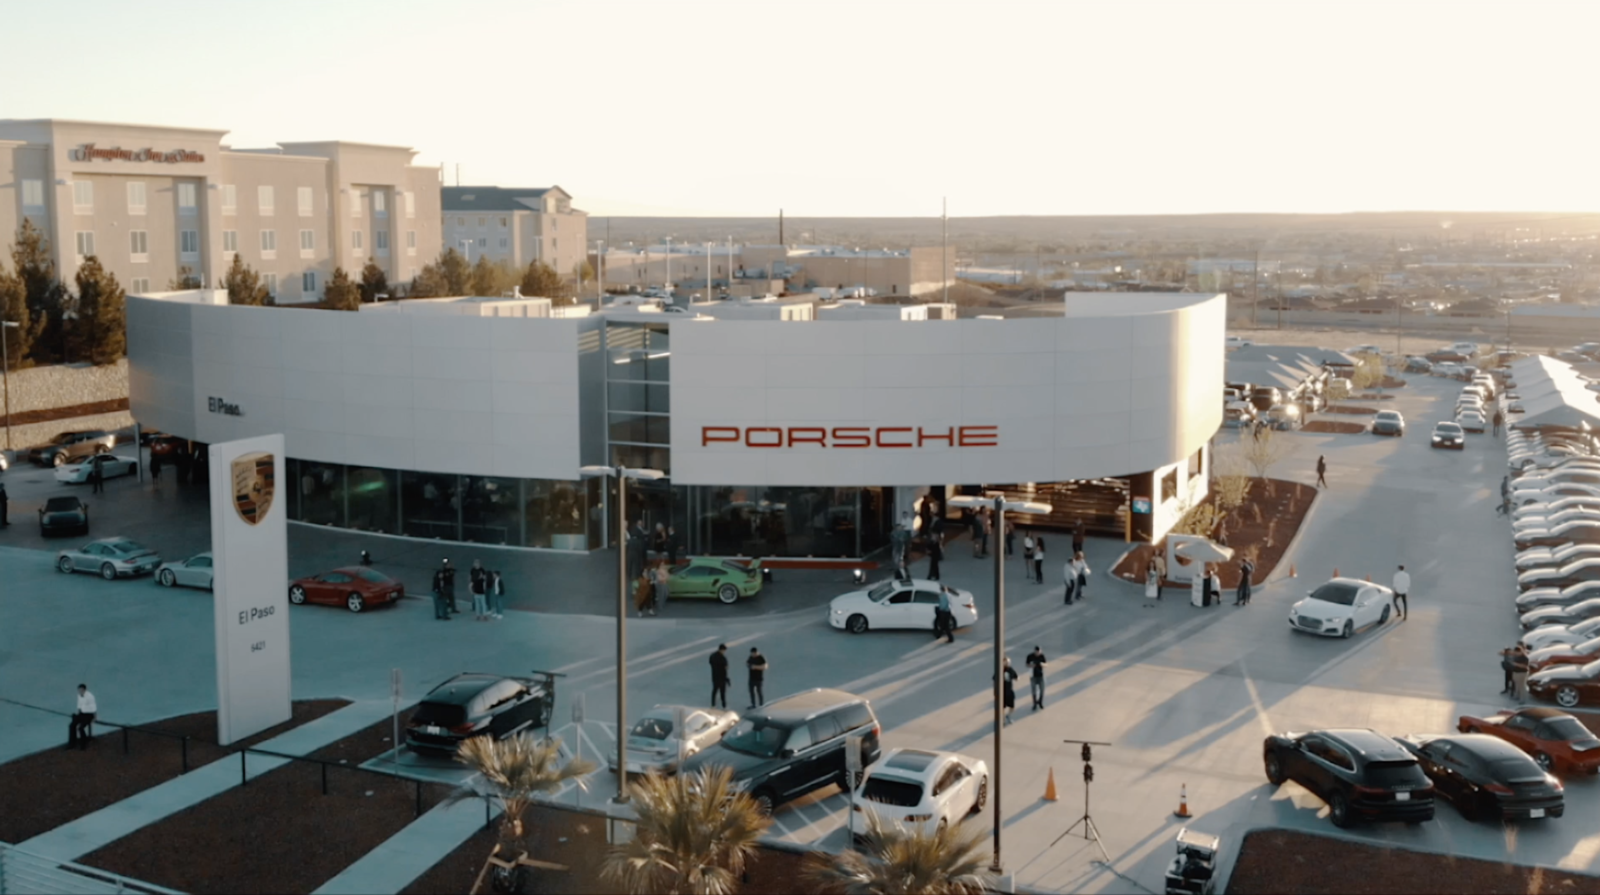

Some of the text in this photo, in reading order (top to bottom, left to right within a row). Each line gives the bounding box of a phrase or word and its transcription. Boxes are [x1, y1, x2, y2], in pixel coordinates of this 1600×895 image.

[702, 426, 998, 447] PORSCHE
[239, 605, 275, 624] El Paso
